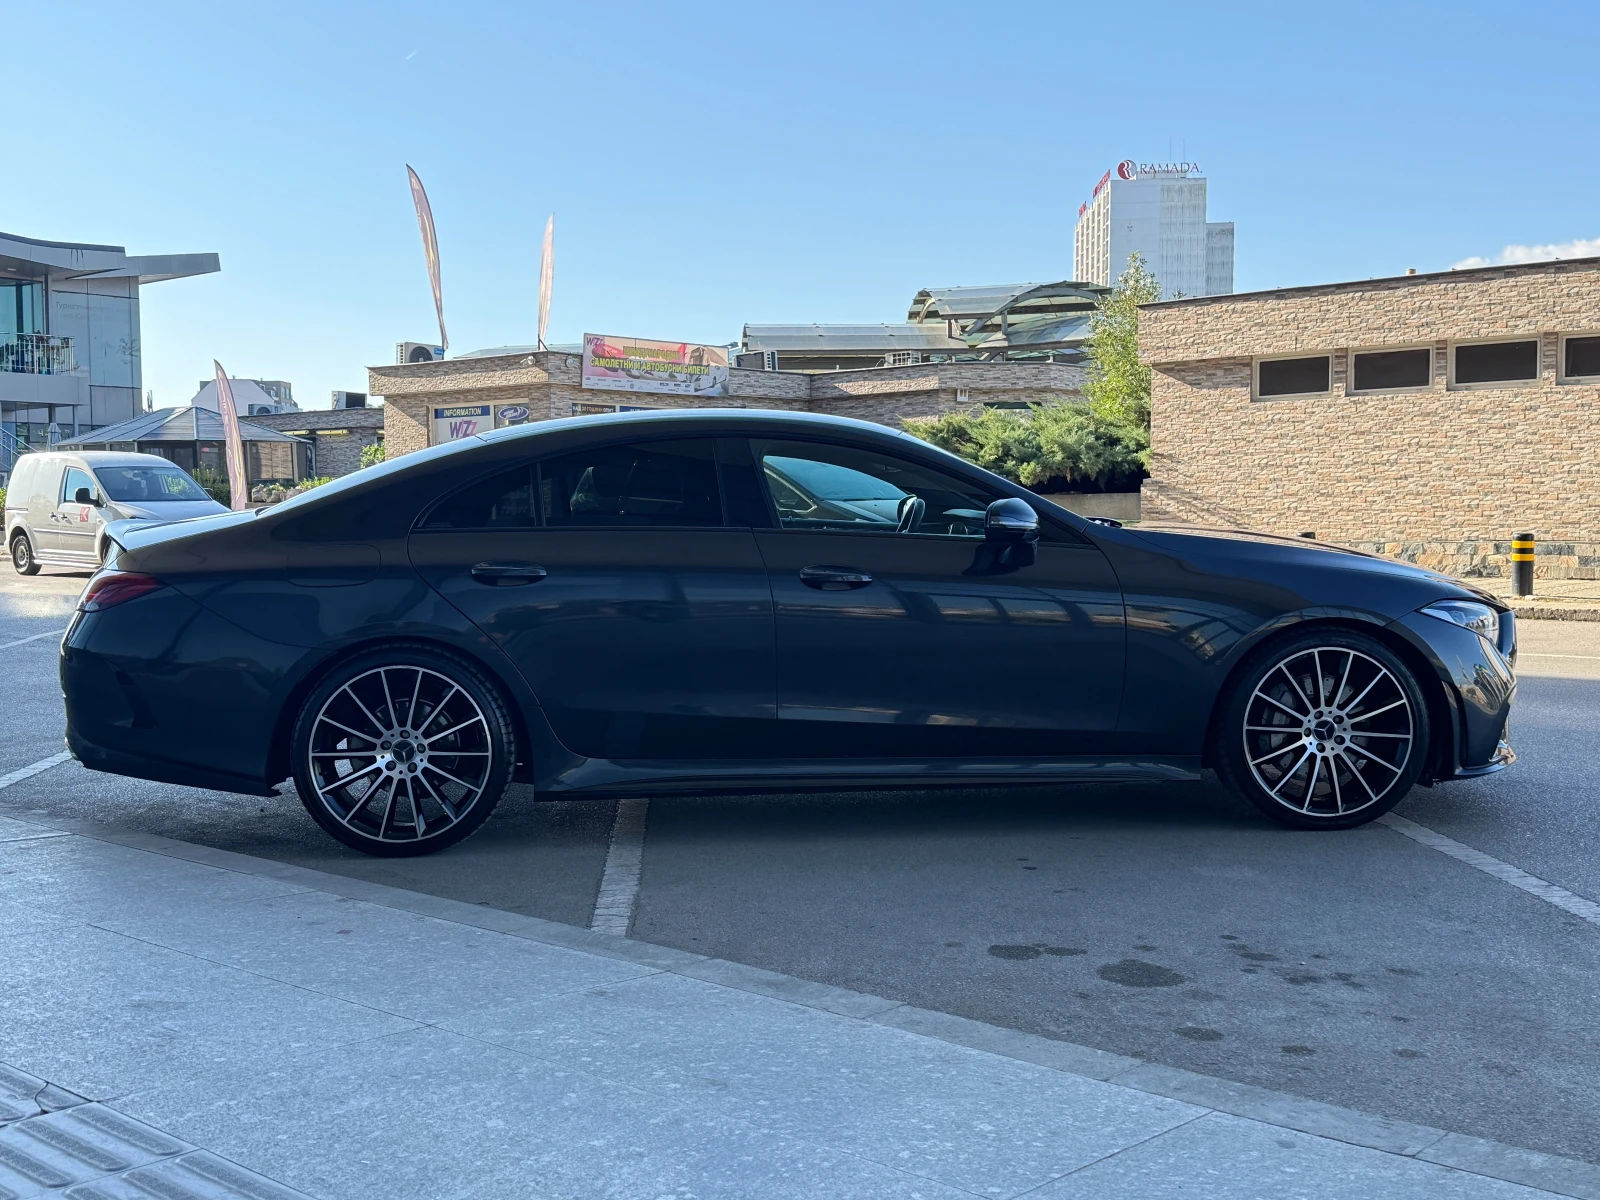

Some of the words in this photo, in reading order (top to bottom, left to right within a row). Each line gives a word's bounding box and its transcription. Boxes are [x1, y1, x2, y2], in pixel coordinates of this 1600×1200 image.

[590, 356, 634, 369] САМОЛЕТНИ
[635, 361, 640, 370] И
[641, 361, 682, 374] АВТОБУСНИ
[683, 364, 710, 375] БИЛЕТИ
[443, 407, 482, 417] INFORMATION
